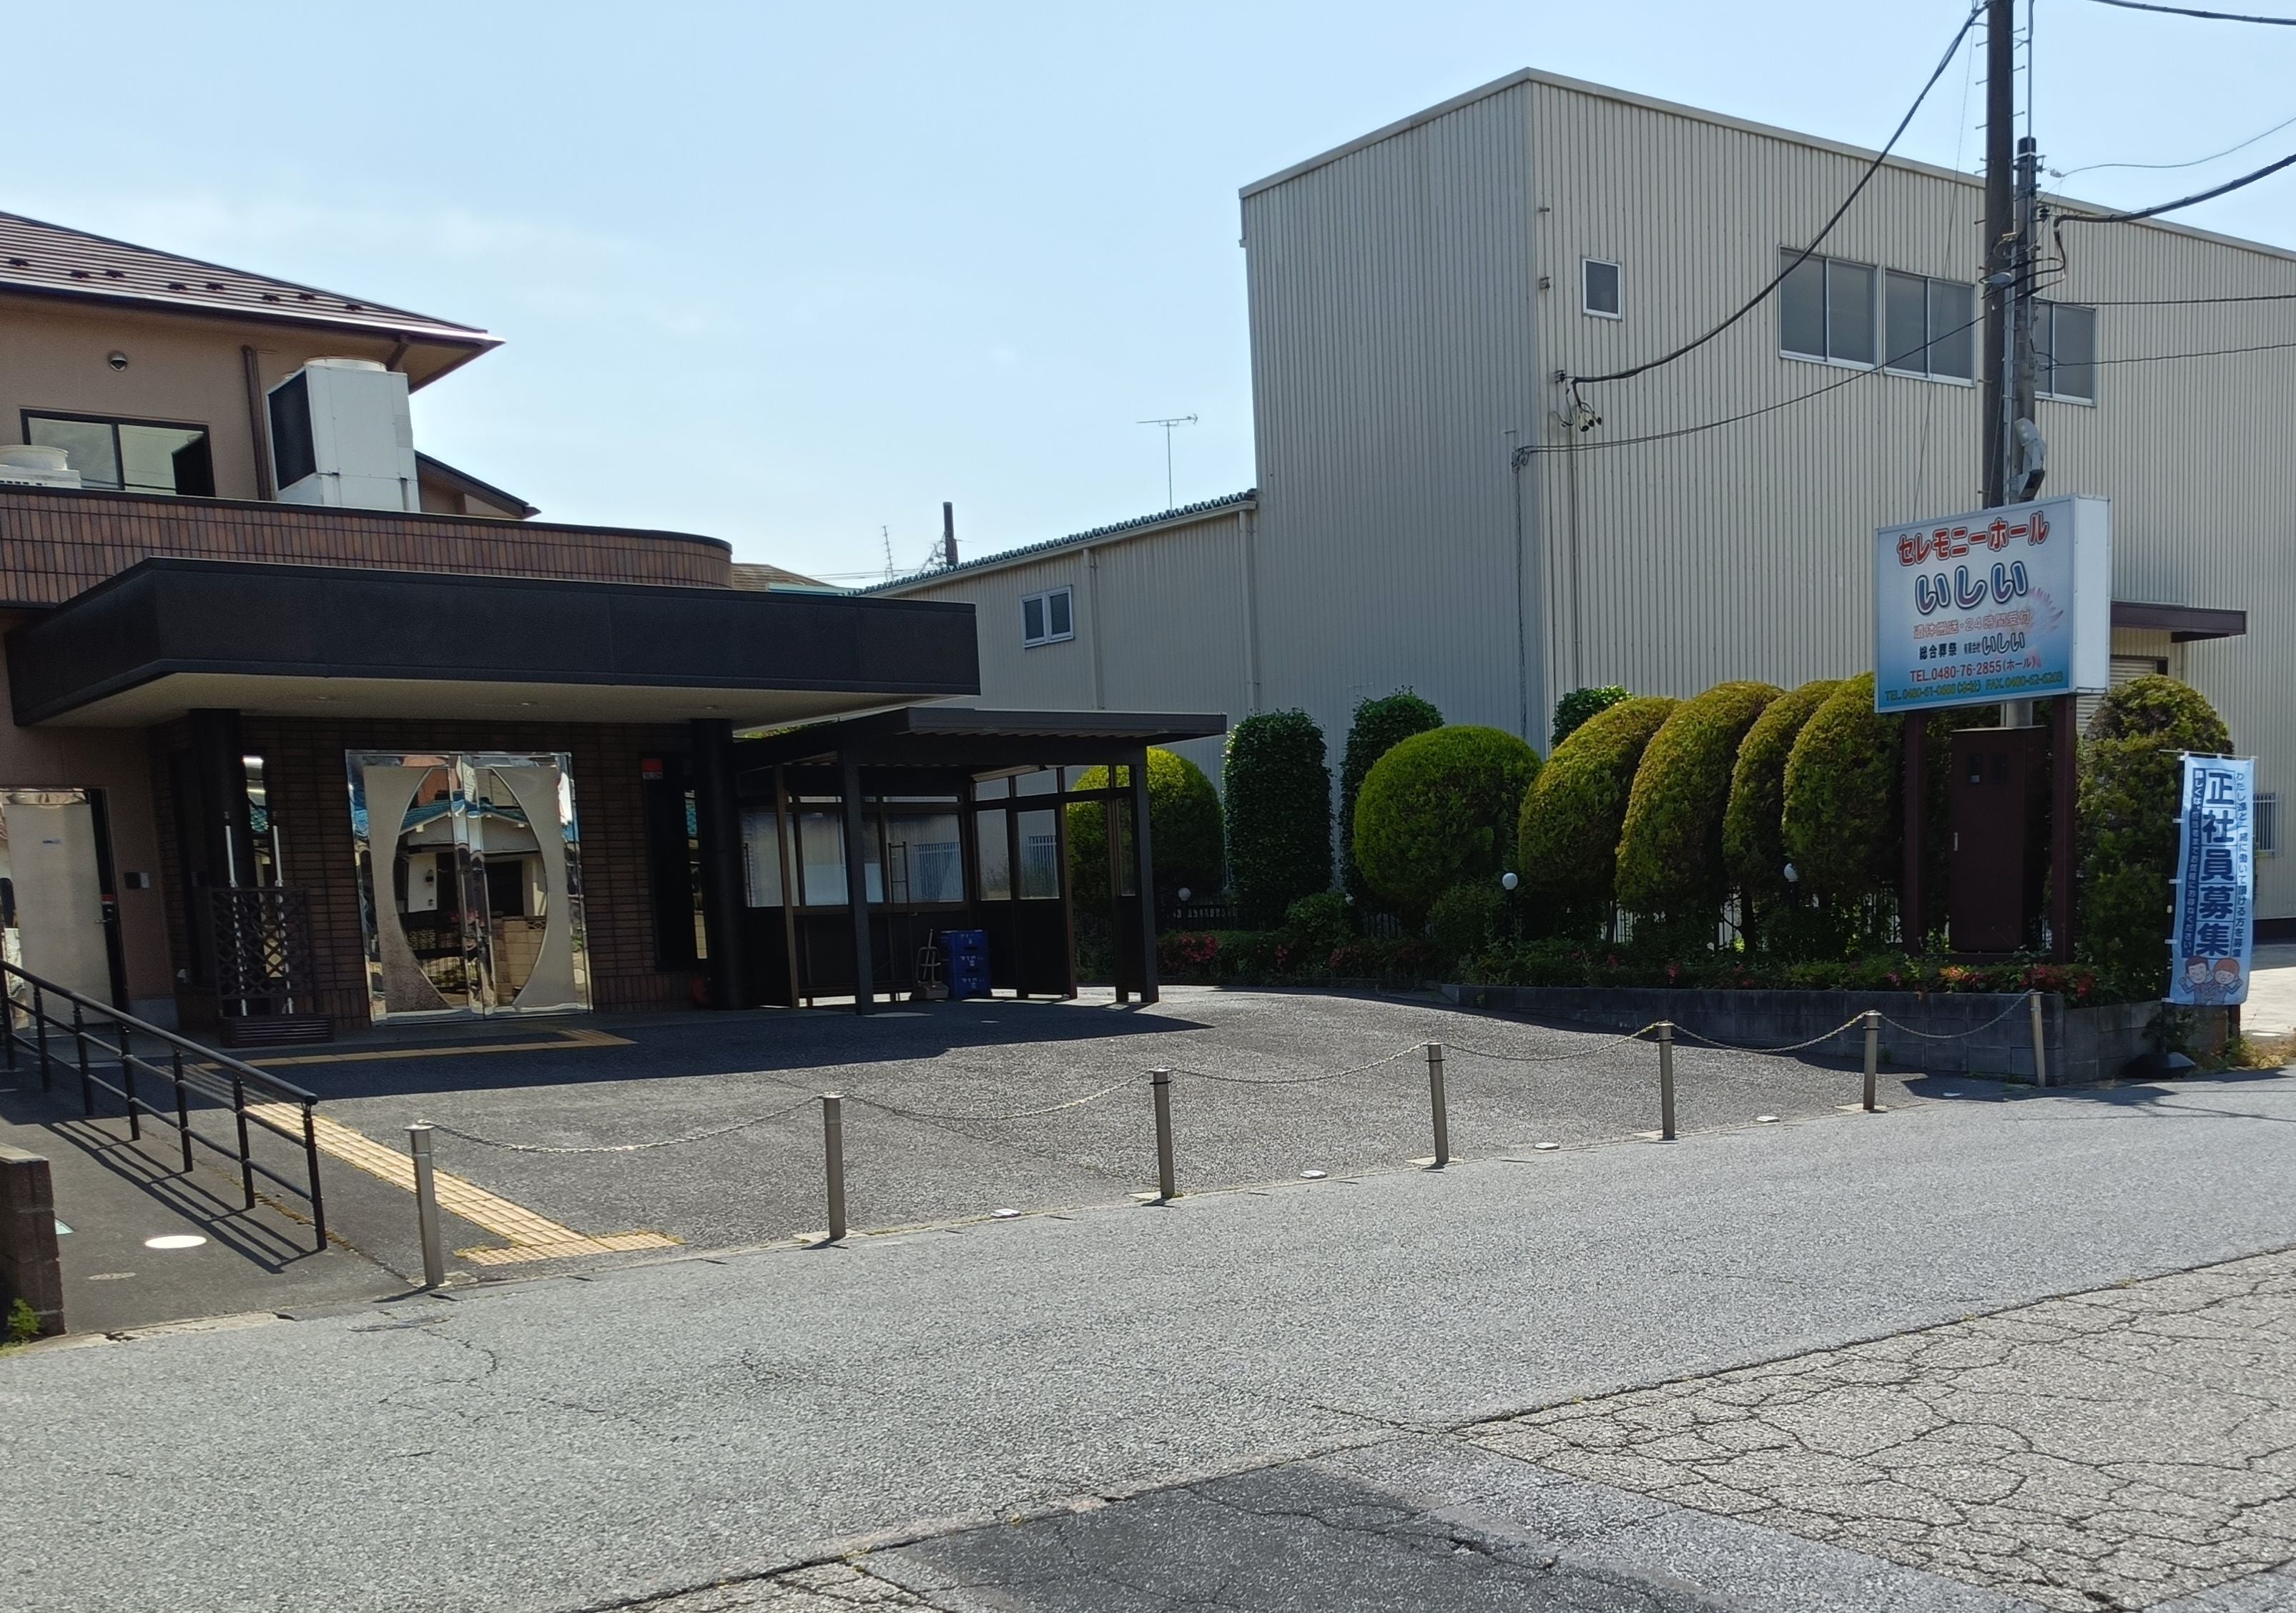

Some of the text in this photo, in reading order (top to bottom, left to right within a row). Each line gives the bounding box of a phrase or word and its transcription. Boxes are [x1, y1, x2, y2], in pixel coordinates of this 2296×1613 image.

[1897, 510, 2049, 566] セレモニーホール
[1916, 561, 2029, 615] いしい
[1919, 642, 1957, 660] 総合葬祭
[2195, 771, 2235, 957] 正社員募集
